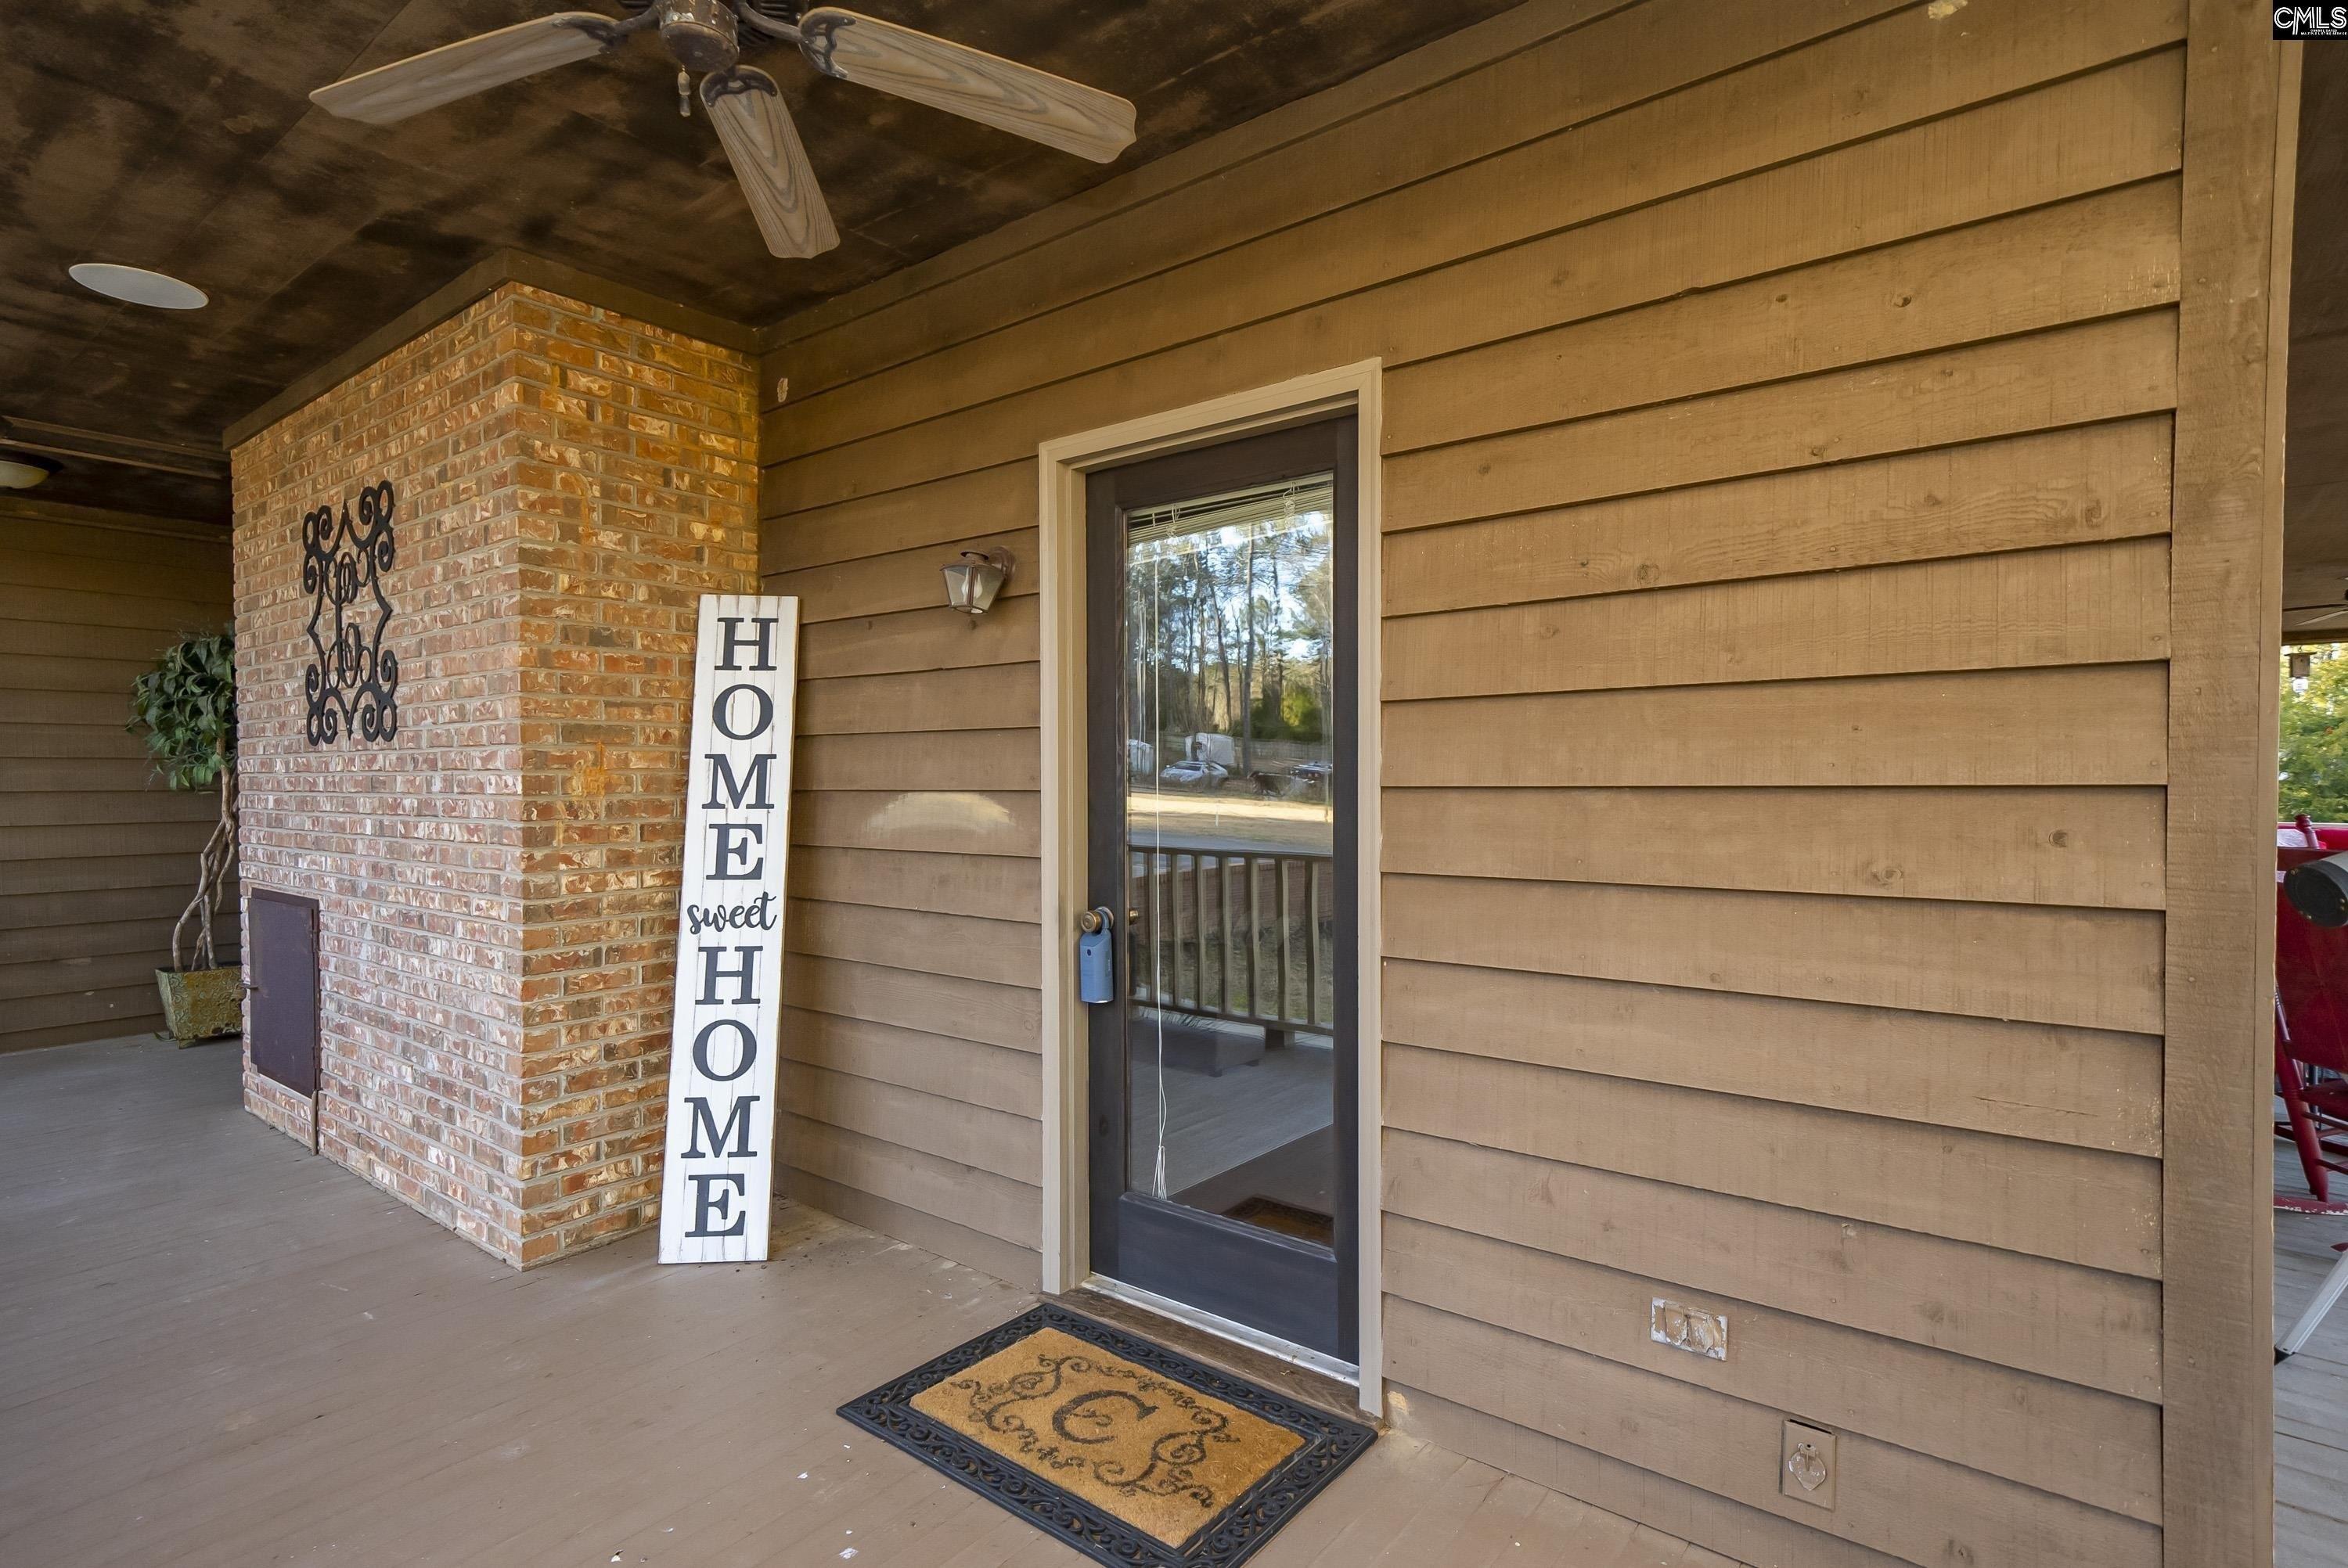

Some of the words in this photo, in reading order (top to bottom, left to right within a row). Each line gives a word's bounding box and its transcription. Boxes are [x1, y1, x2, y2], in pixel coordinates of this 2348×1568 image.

[701, 617, 780, 880] HOME
[686, 890, 777, 935] sweet
[680, 945, 764, 1239] HOME
[1051, 1390, 1159, 1444] C
